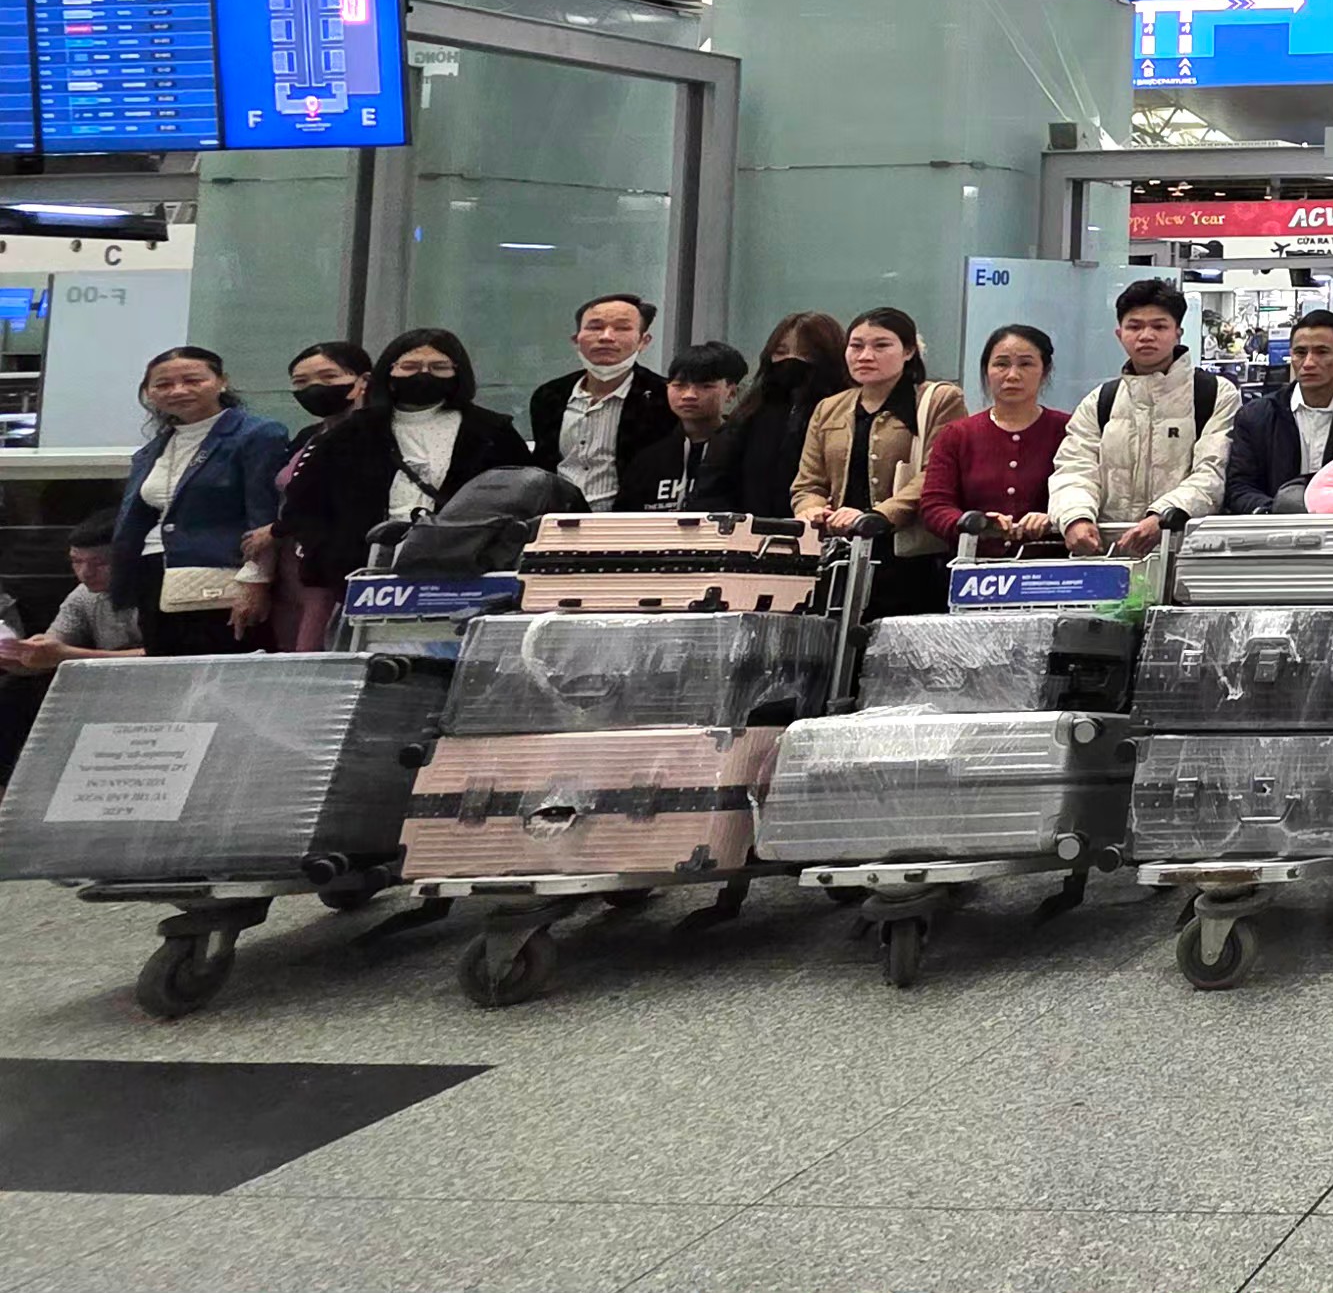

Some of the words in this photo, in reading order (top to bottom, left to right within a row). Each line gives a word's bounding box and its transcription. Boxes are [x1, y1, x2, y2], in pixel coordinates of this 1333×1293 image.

[247, 110, 263, 128] F
[361, 108, 377, 126] E
[1155, 211, 1186, 226] New
[1191, 211, 1226, 226] Year
[1297, 236, 1315, 245] CỬA
[1317, 237, 1329, 245] RA
[105, 245, 122, 266] C
[976, 268, 1010, 287] E-00
[1168, 428, 1180, 438] R
[958, 575, 1016, 597] ACV
[354, 586, 415, 607] ACV
